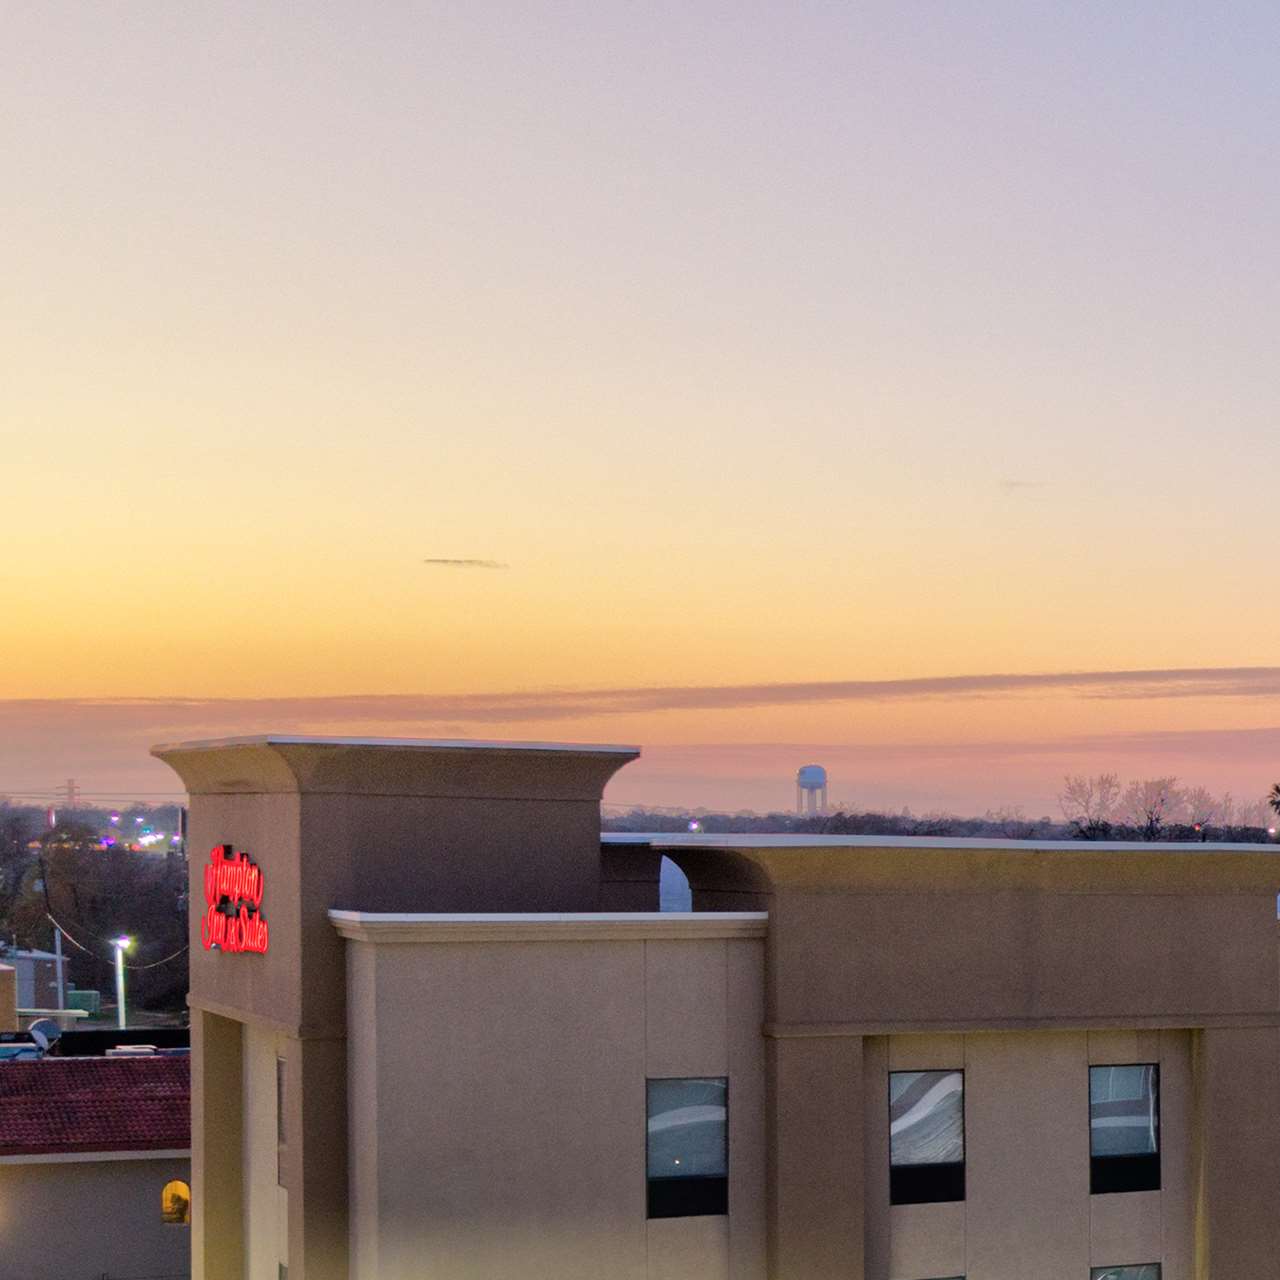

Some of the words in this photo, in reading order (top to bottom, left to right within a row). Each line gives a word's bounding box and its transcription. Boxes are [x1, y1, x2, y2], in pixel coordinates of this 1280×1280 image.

[204, 844, 264, 909] Hampton
[201, 903, 229, 952] Inn
[239, 903, 269, 954] Suites
